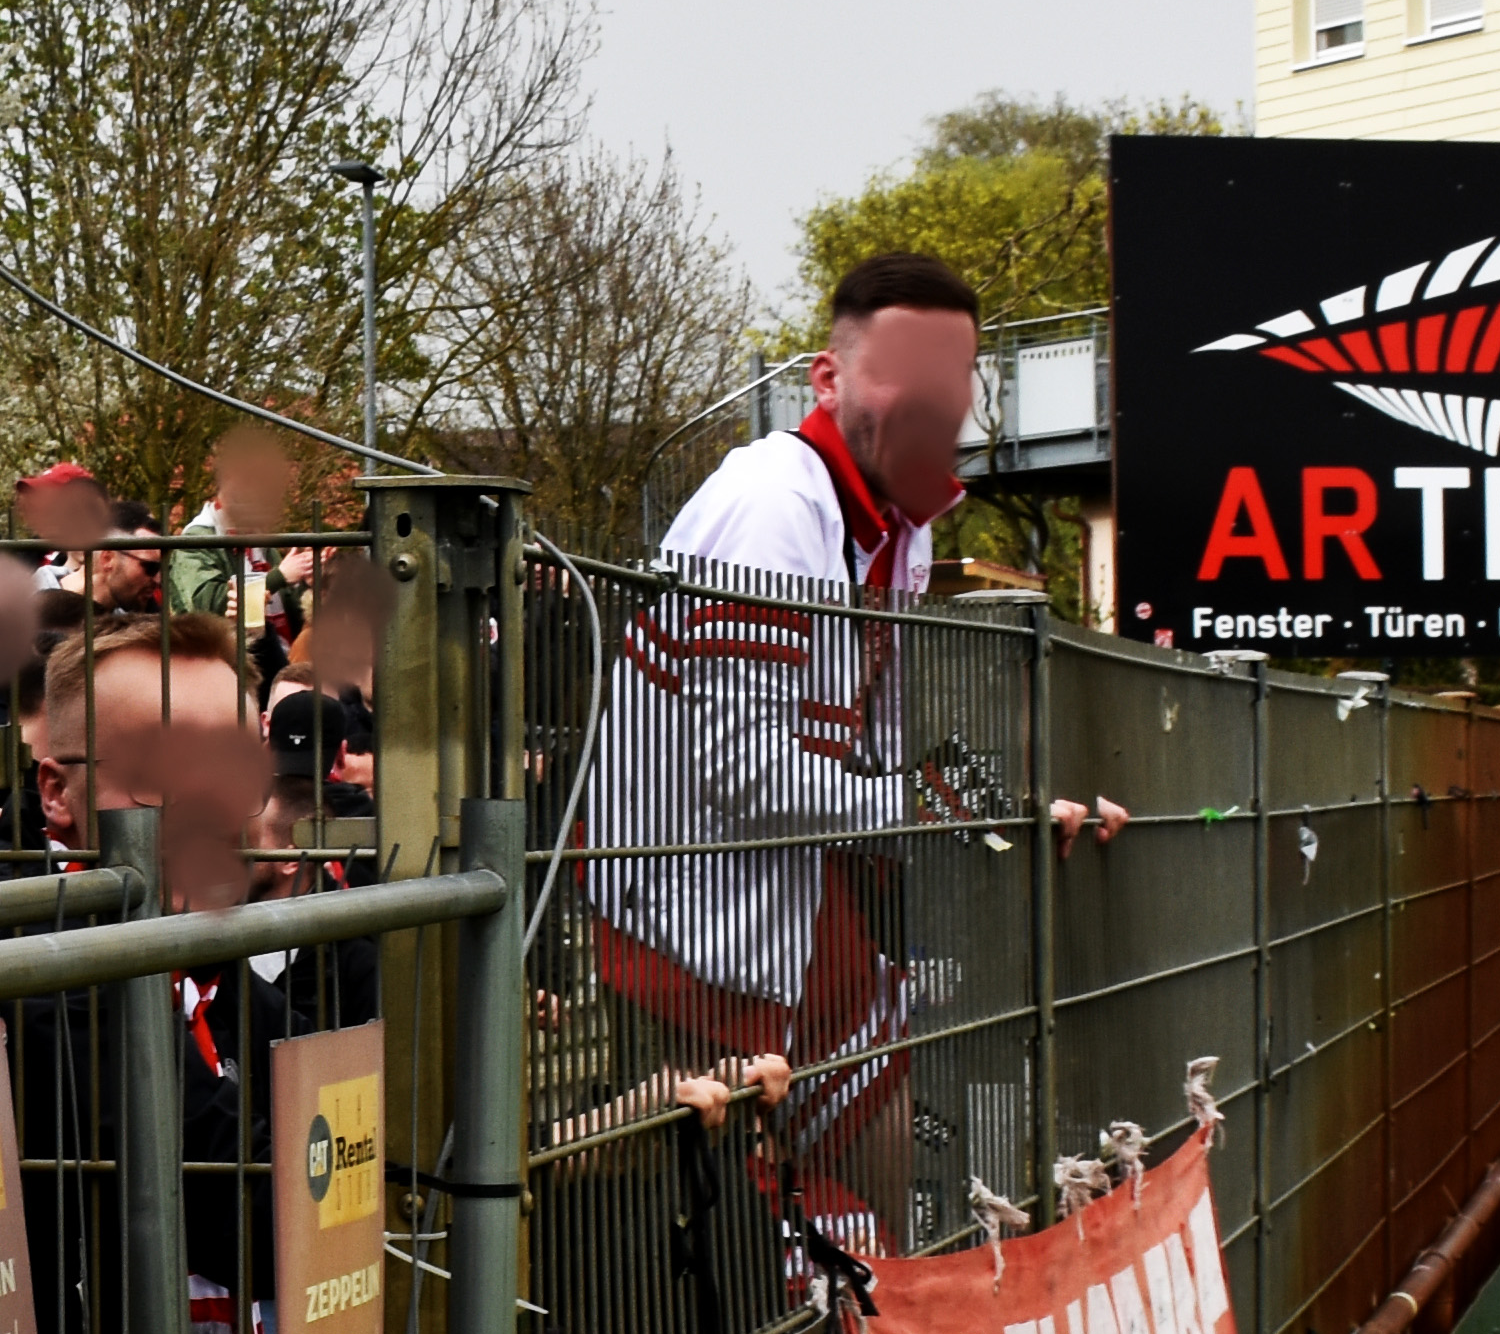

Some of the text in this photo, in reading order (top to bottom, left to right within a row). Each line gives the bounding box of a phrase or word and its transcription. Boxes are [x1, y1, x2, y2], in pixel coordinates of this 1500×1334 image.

[1193, 607, 1333, 639] Fenster
[1364, 606, 1466, 638] Türen
[306, 1261, 381, 1323] ZEPPELIN
